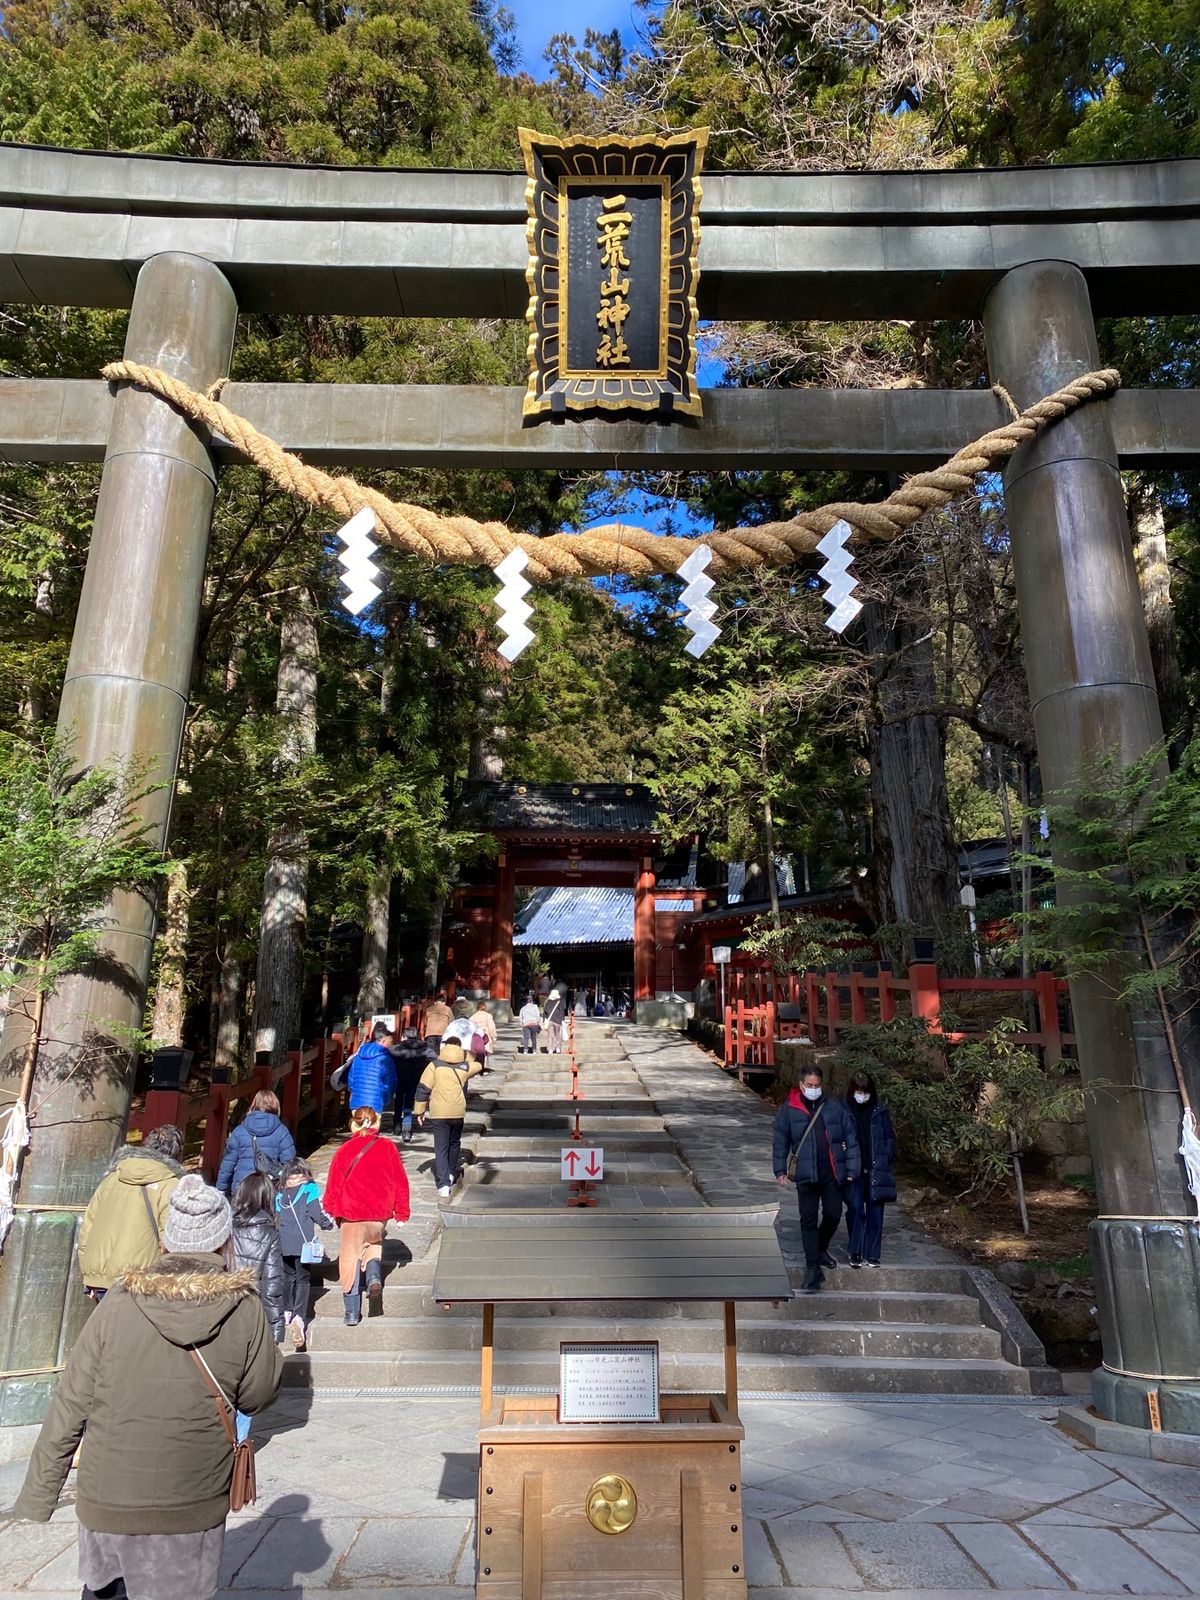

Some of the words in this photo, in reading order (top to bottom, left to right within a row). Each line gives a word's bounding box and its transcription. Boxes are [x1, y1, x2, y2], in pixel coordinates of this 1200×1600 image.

[596, 194, 633, 367] 二荒山神社
